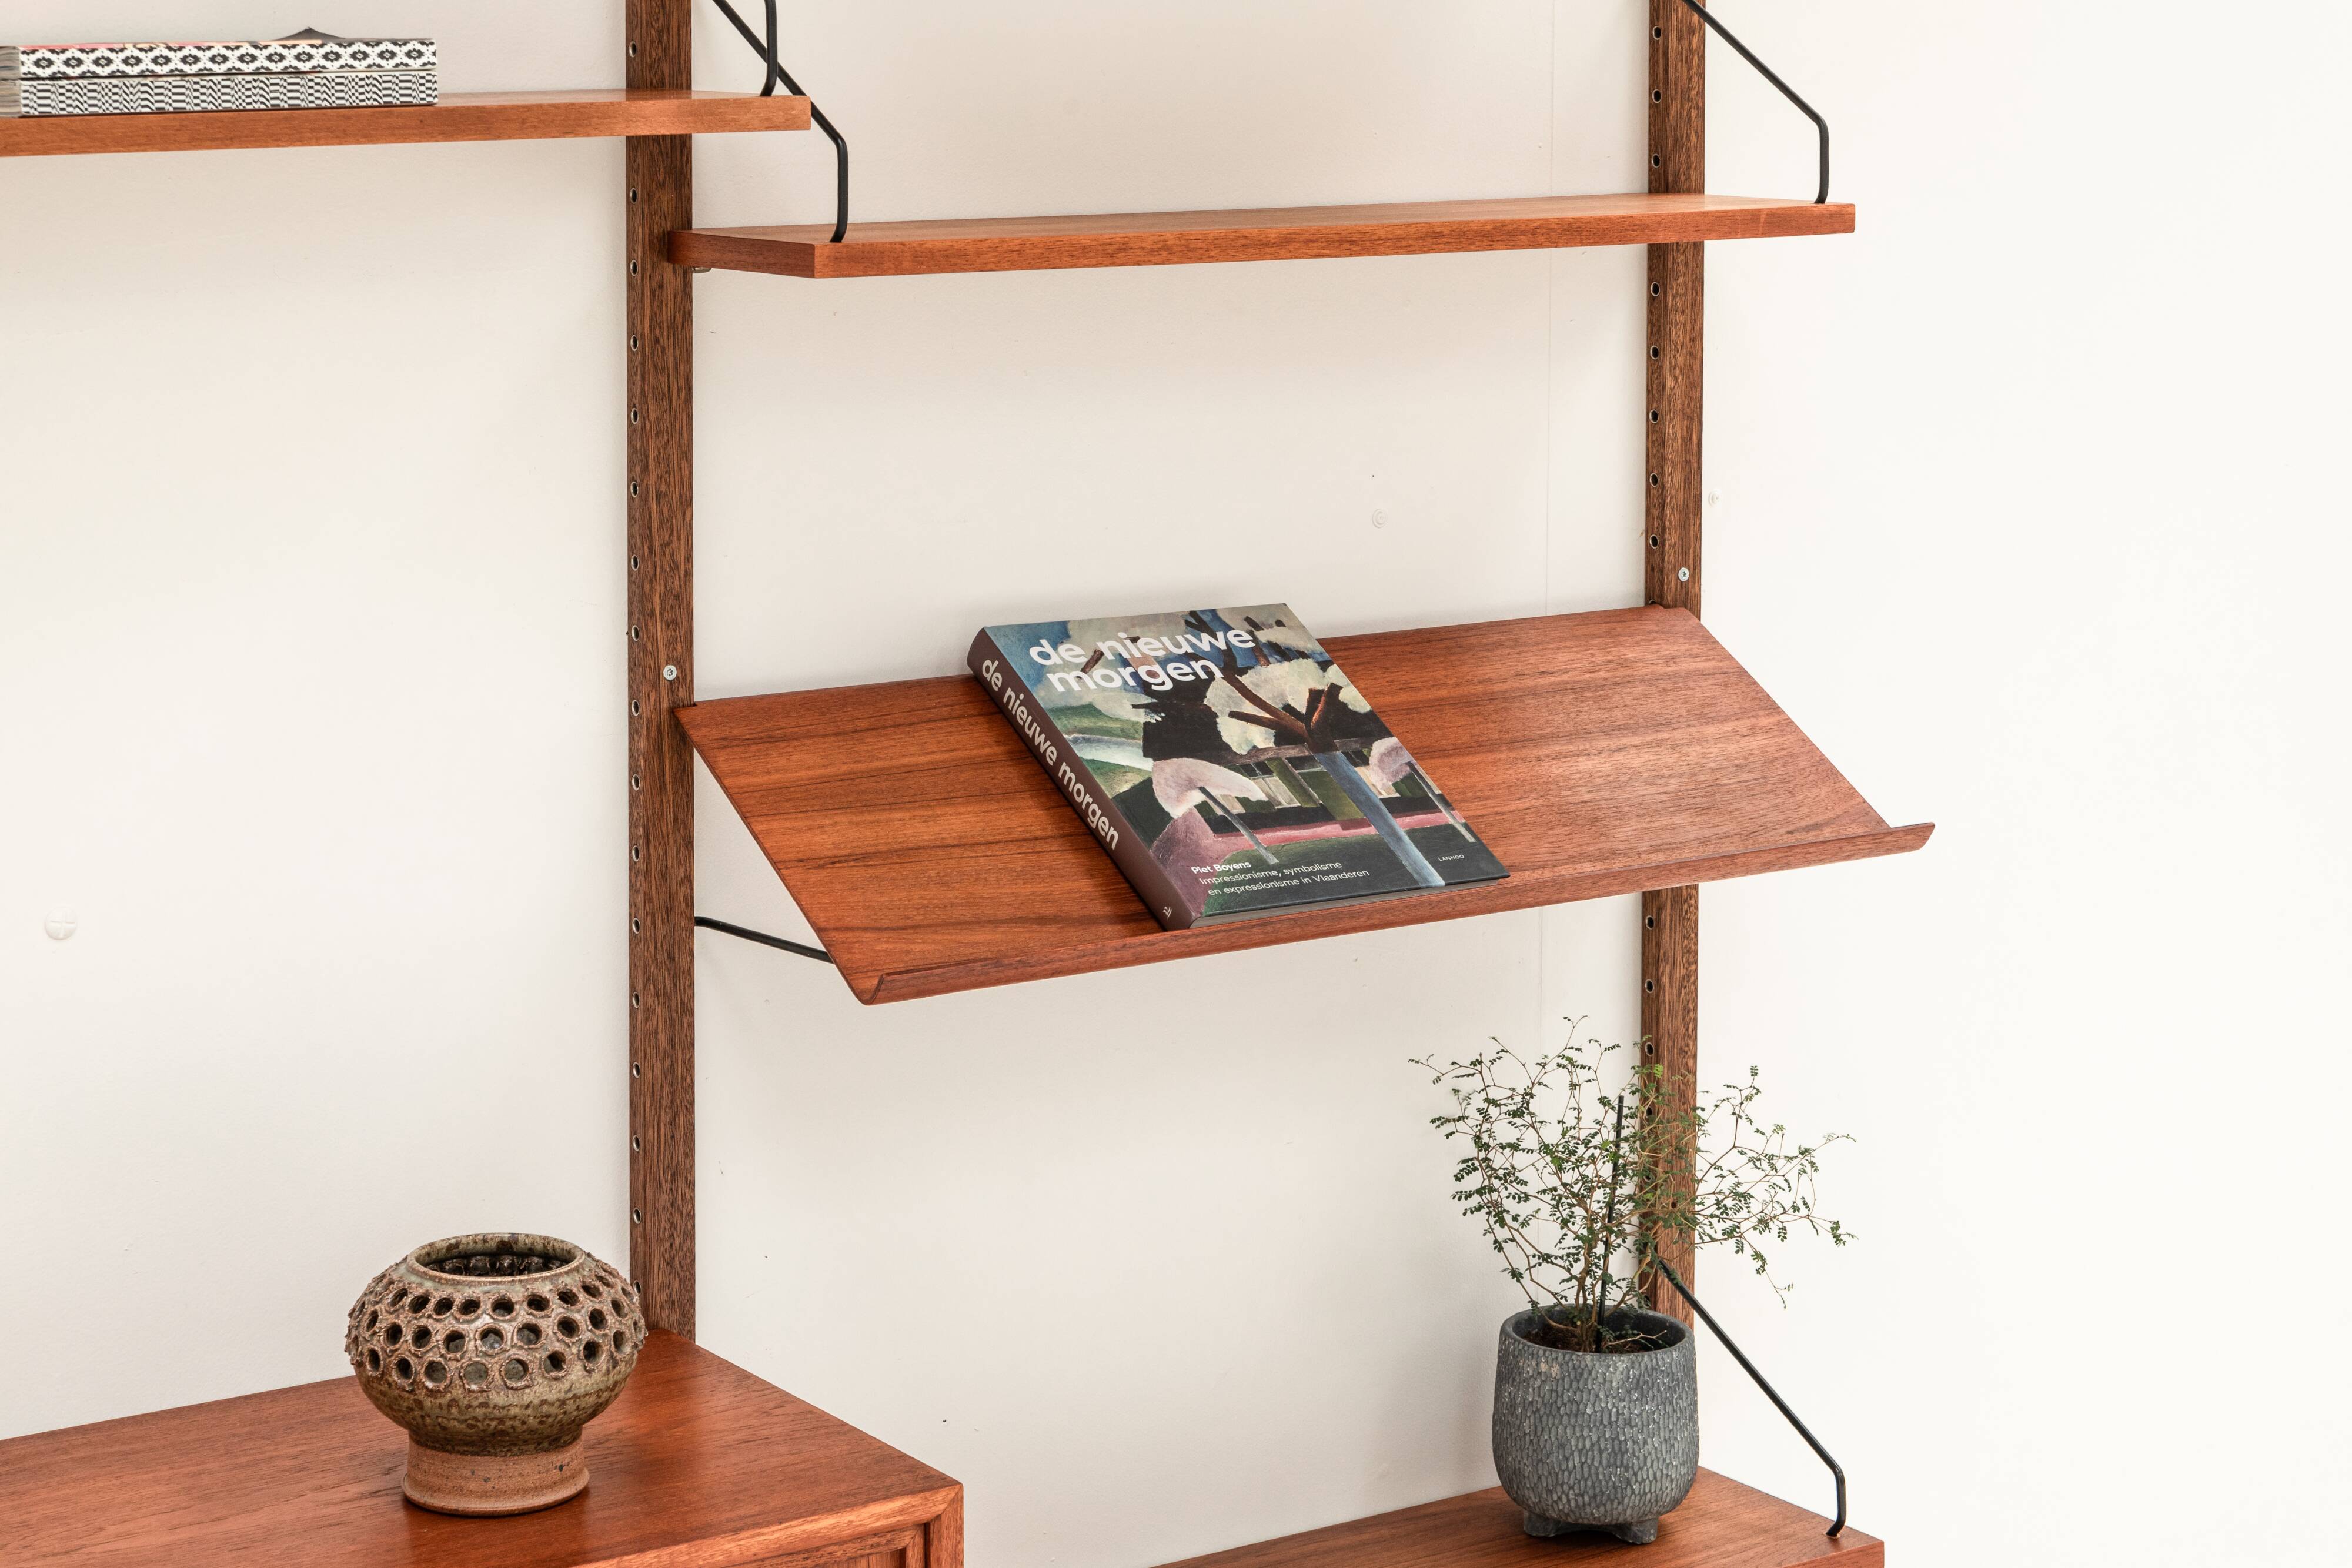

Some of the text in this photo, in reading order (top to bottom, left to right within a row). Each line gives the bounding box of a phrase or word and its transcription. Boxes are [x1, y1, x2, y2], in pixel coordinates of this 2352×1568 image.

[1029, 629, 1256, 666] de nieuwe
[1047, 659, 1224, 691] morgen
[982, 659, 1119, 850] de nieuwe morgen
[1191, 861, 1252, 874] Piet Boyens
[1199, 862, 1342, 885] Impressionisme, symbolisme
[1223, 878, 1299, 894] expressionisme
[1313, 870, 1370, 882] Vlaanderen
